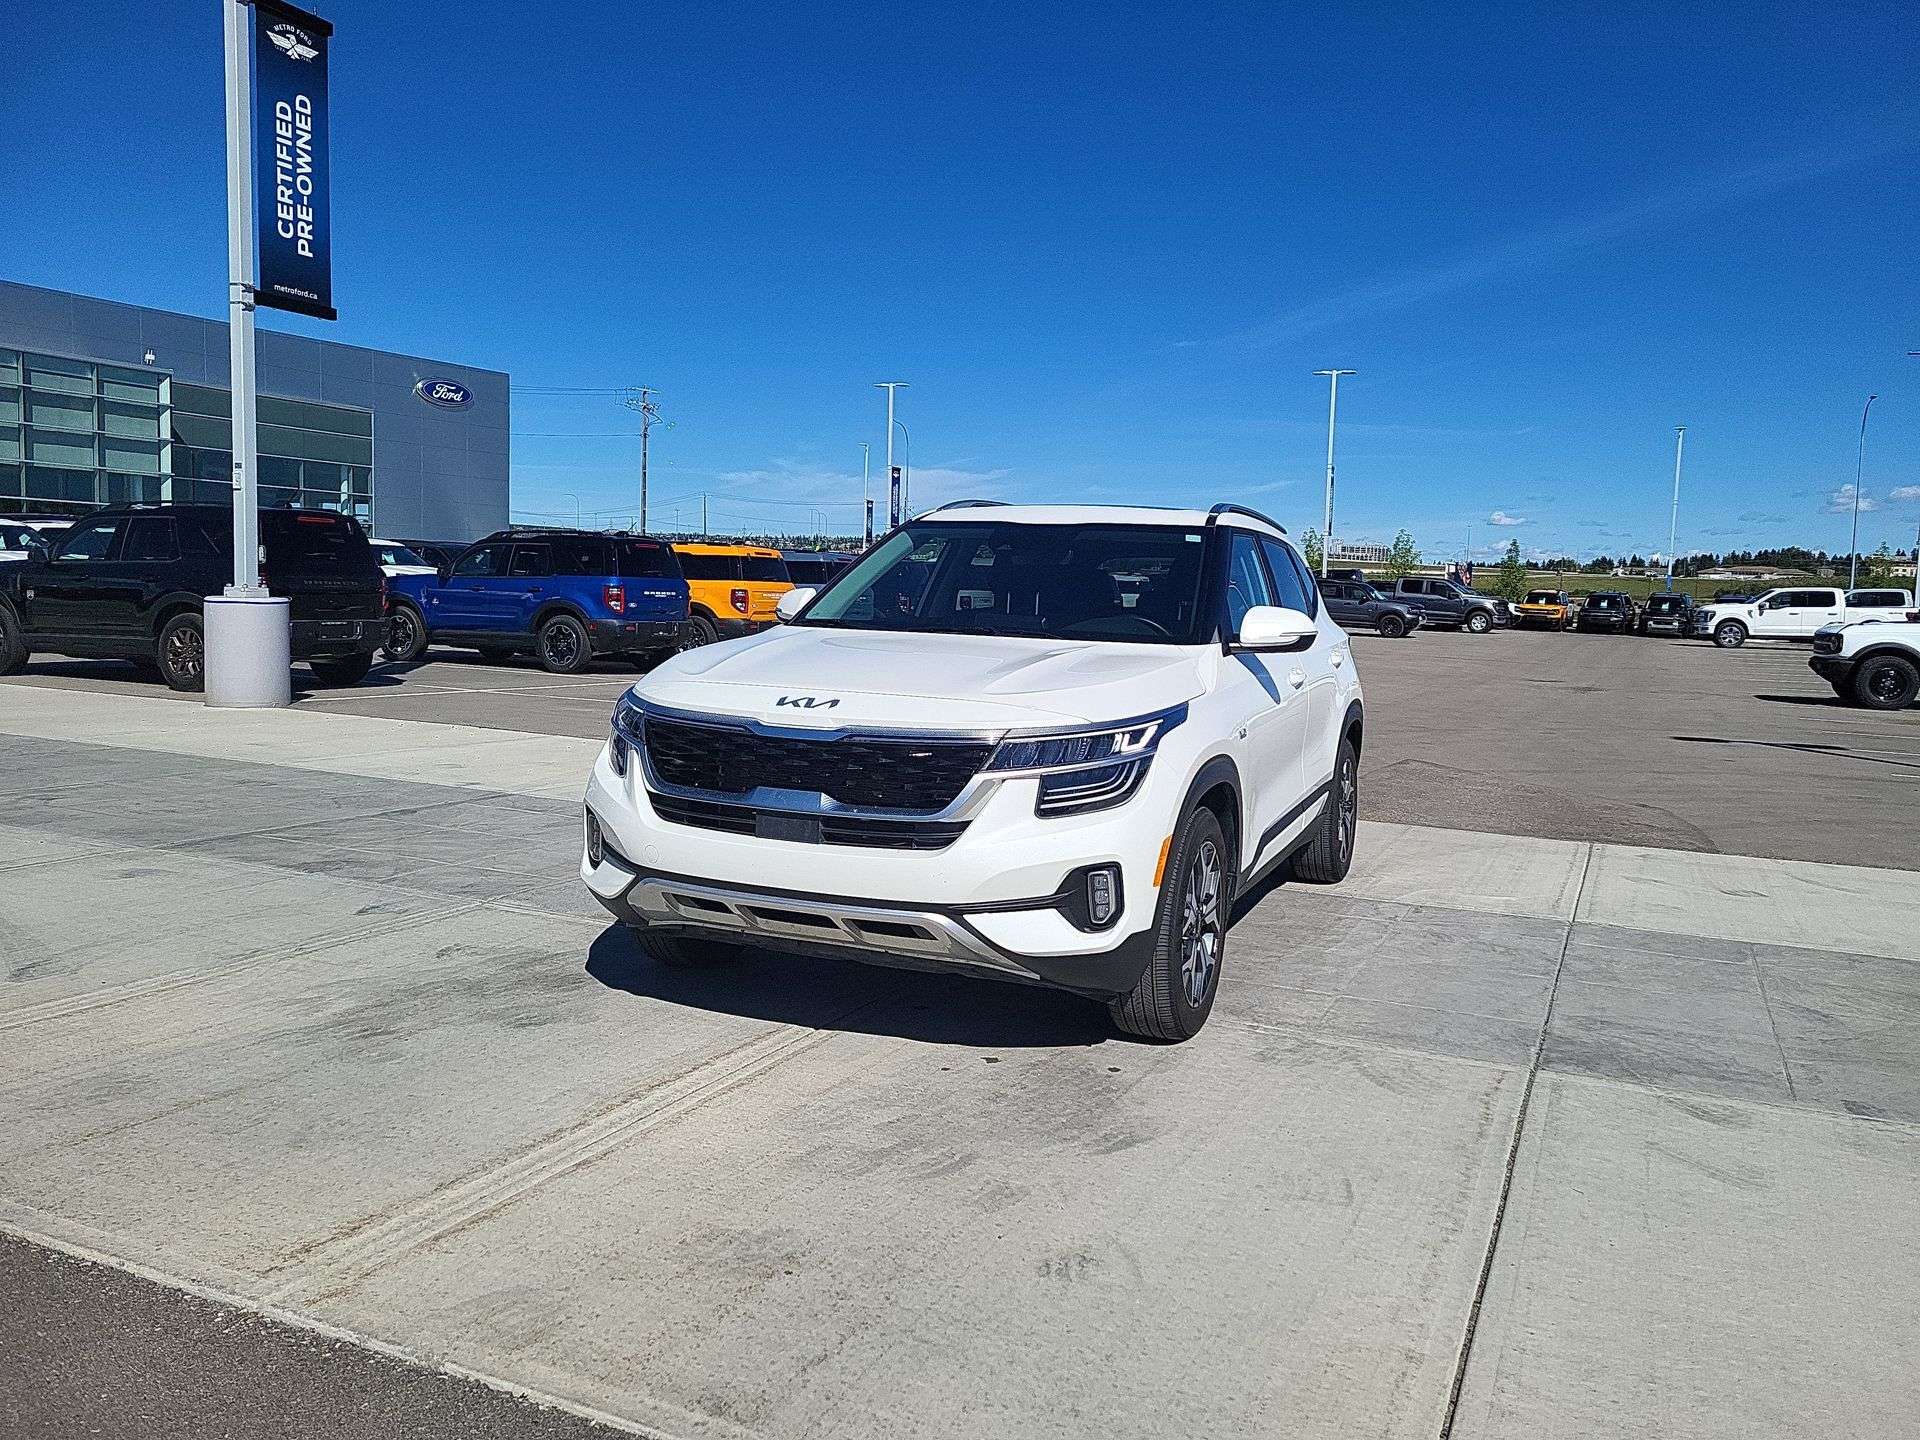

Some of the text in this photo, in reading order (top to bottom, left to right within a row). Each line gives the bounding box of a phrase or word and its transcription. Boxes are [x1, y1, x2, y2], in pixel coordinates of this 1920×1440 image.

[273, 24, 312, 46] METRO FORD
[276, 101, 294, 239] CERTIFIED
[295, 94, 314, 258] PRE-OWNED
[273, 284, 318, 300] metroford.ca
[432, 383, 464, 402] Ford
[776, 696, 841, 709] KIA
